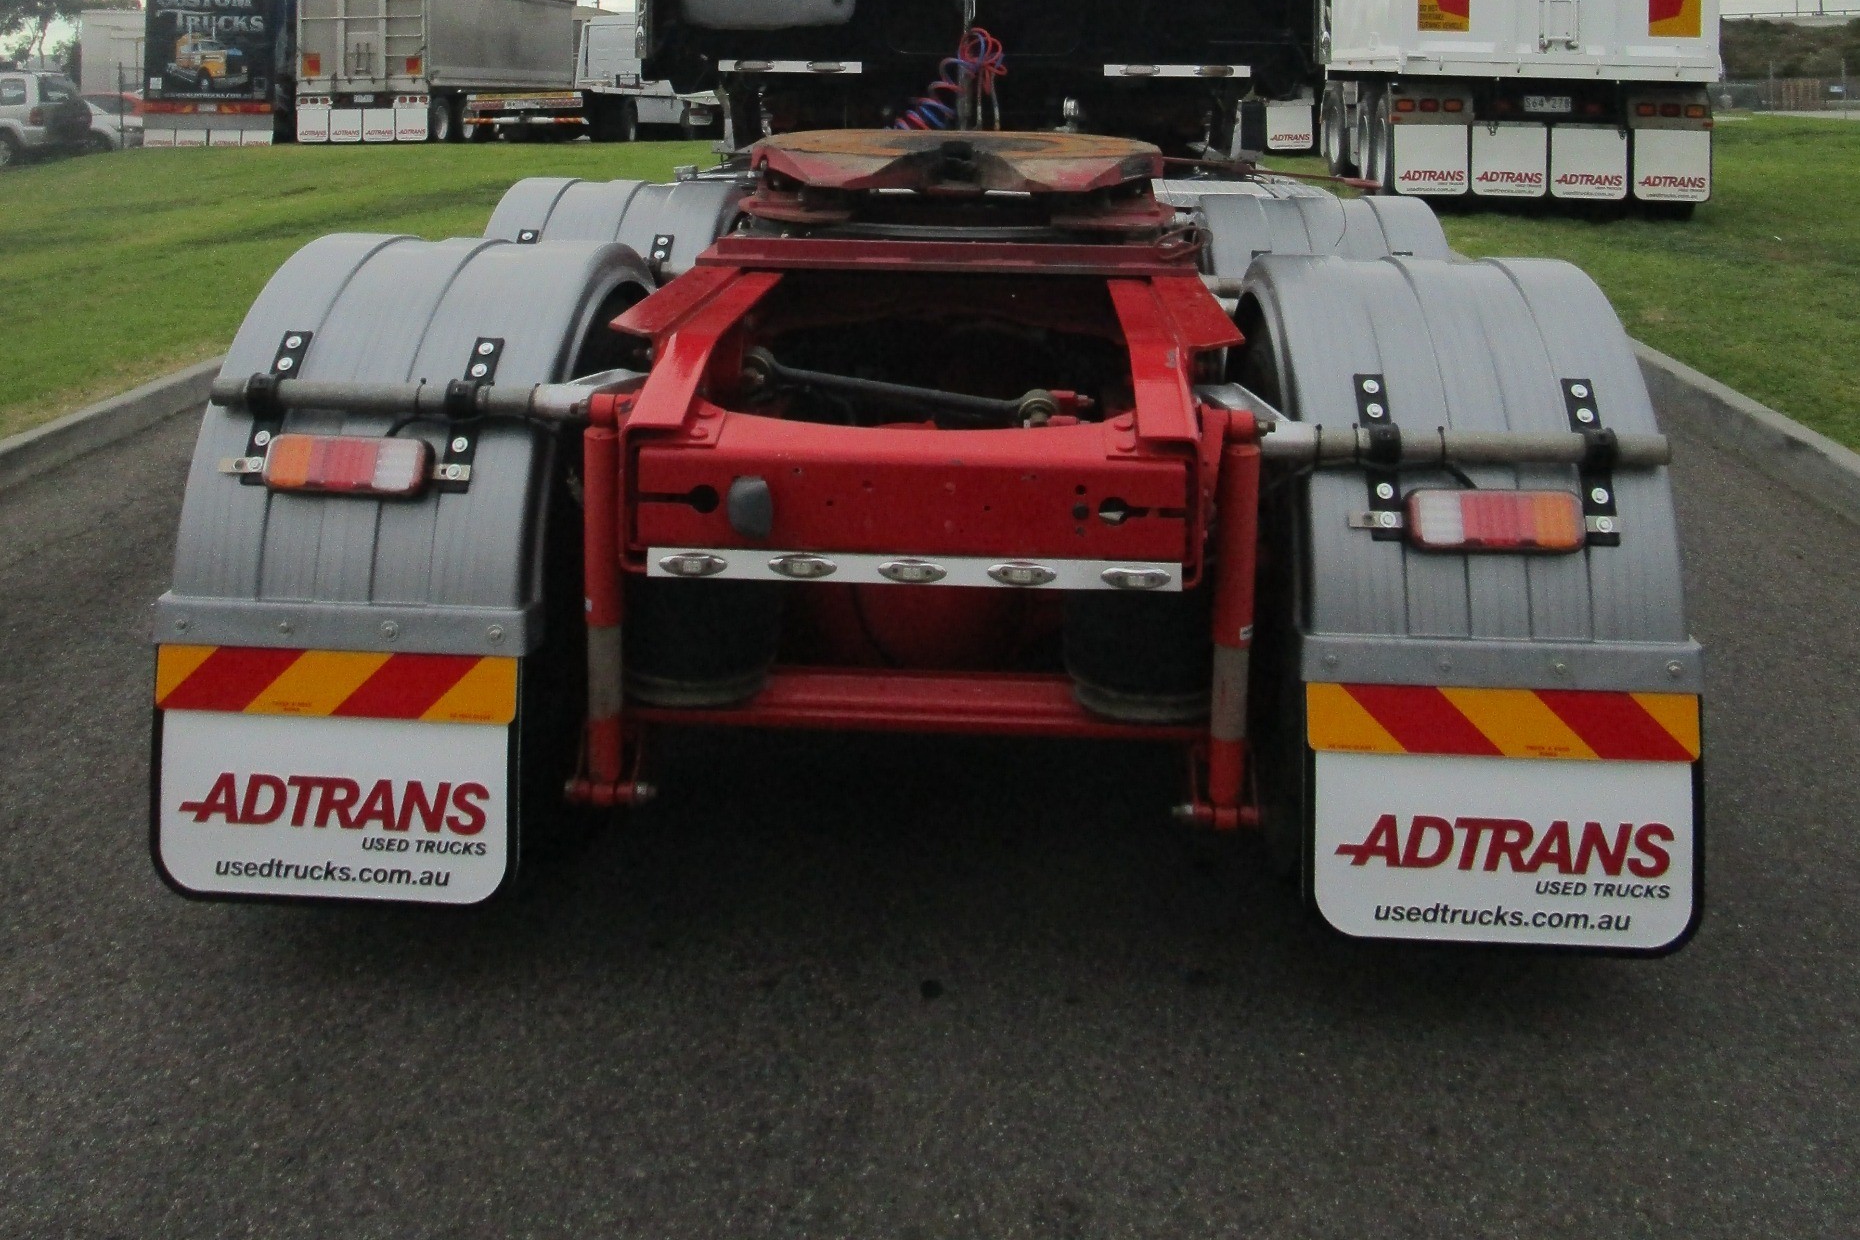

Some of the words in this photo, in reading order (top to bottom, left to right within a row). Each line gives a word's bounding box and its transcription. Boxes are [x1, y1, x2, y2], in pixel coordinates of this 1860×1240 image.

[156, 8, 264, 33] TRUCKS
[1270, 133, 1310, 141] ADTRANS
[1399, 170, 1464, 182] ADTRANS
[1476, 171, 1543, 184] ADTRANS
[1555, 173, 1623, 187] ADTRANS
[1638, 175, 1706, 188] ADTRANS
[178, 772, 490, 836] ADTRANS
[361, 836, 409, 854] USED
[415, 838, 488, 857] TRUCKS
[1334, 813, 1675, 879] ADTRANS
[215, 857, 451, 887] usedtrucks.com.au
[1535, 879, 1588, 897] USED
[1593, 881, 1672, 900] TRUCKS
[1373, 902, 1632, 932] usedtrucks.com.au
